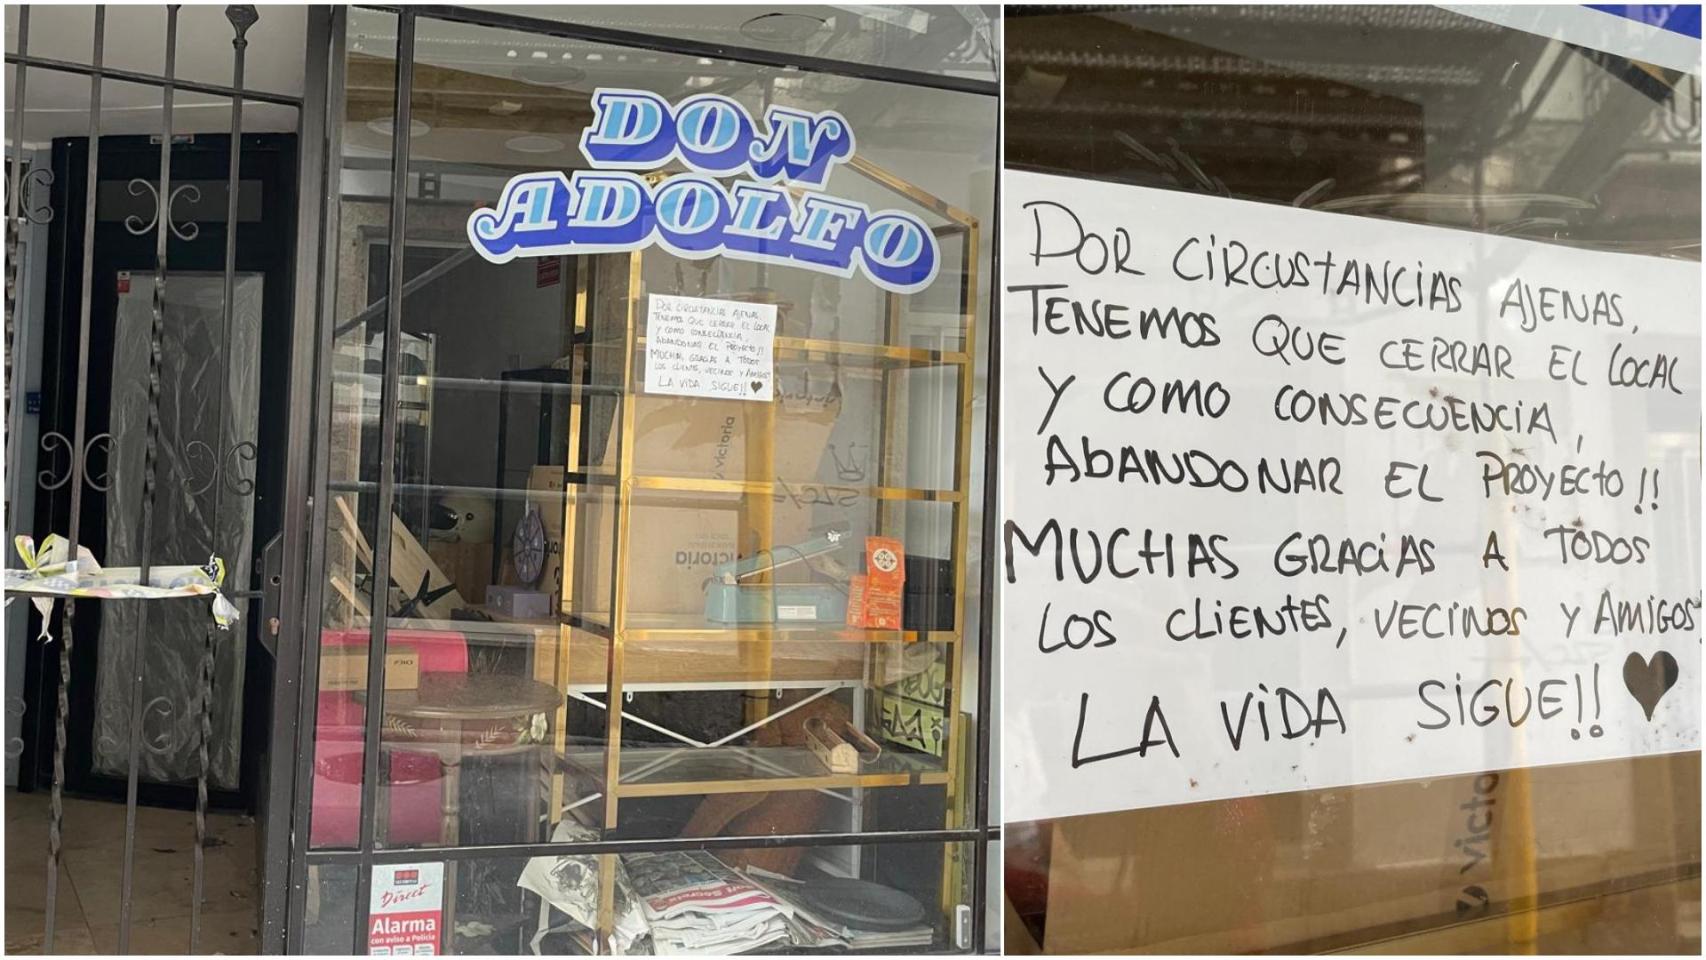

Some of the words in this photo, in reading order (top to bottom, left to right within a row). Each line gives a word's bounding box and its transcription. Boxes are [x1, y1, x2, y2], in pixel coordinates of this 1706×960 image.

[583, 91, 853, 187] DON
[471, 174, 936, 289] ADOLFO
[1023, 201, 1145, 275] POR
[1500, 279, 1638, 334] AJENAS,
[1008, 284, 1220, 348] TENEMOS
[1252, 314, 1345, 365] QUE
[1380, 339, 1514, 379] CERRAR
[1549, 345, 1587, 385] EL
[1608, 343, 1682, 395] LOCAL
[1037, 366, 1076, 435] Y
[1104, 371, 1230, 419] COMO
[715, 416, 736, 469] victoria
[1385, 461, 1444, 502] EL
[675, 551, 735, 570] ictoria
[1004, 518, 1239, 584] MUCHAS
[1274, 532, 1435, 578] GRACIAS
[1483, 531, 1509, 571] A
[1544, 527, 1650, 564] TODOS
[1039, 602, 1116, 653] LOS
[1375, 600, 1527, 639] VECINOS
[1560, 603, 1580, 638] Y
[1072, 692, 1180, 769] LA
[1220, 683, 1346, 751] VIDA
[380, 884, 432, 908] Direct
[371, 917, 436, 935] Alarma
[371, 937, 385, 945] con
